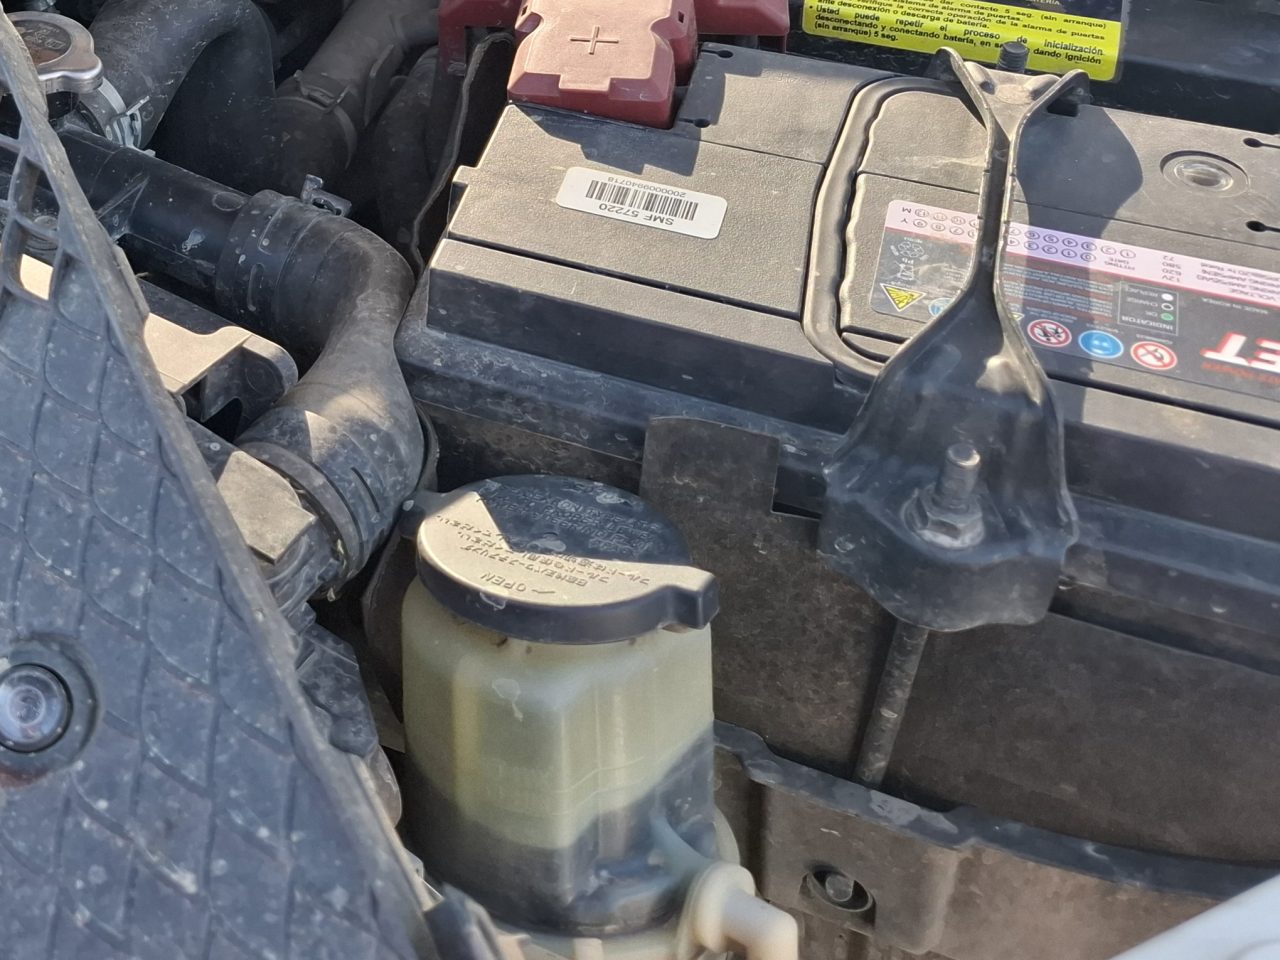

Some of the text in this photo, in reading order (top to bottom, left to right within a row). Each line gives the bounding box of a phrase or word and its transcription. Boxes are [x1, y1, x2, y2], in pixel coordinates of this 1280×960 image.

[837, 0, 890, 13] desconexión
[900, 10, 940, 22] descarga
[956, 18, 990, 28] batería.
[907, 5, 943, 15] correcta
[1022, 23, 1051, 32] alarma
[941, 5, 971, 13] alarma
[959, 1, 998, 12] contacto
[1063, 17, 1106, 29] arranque)
[814, 21, 831, 29] (sin
[831, 24, 872, 36] arranque)
[880, 32, 898, 41] seg.
[814, 13, 878, 29] desconectando
[888, 24, 940, 39] conectando
[943, 33, 977, 45] batería,
[1033, 47, 1060, 58] dando
[1064, 51, 1101, 65] ignición
[815, 5, 840, 15] Usted
[853, 11, 880, 22] puede
[894, 17, 924, 29] repetir
[963, 27, 1000, 41] proceso
[1016, 35, 1028, 43] de
[1043, 38, 1103, 56] inicialización
[599, 203, 675, 226] SMF 57220
[1122, 315, 1173, 331] INDICATOR
[481, 571, 528, 592] OPEN
